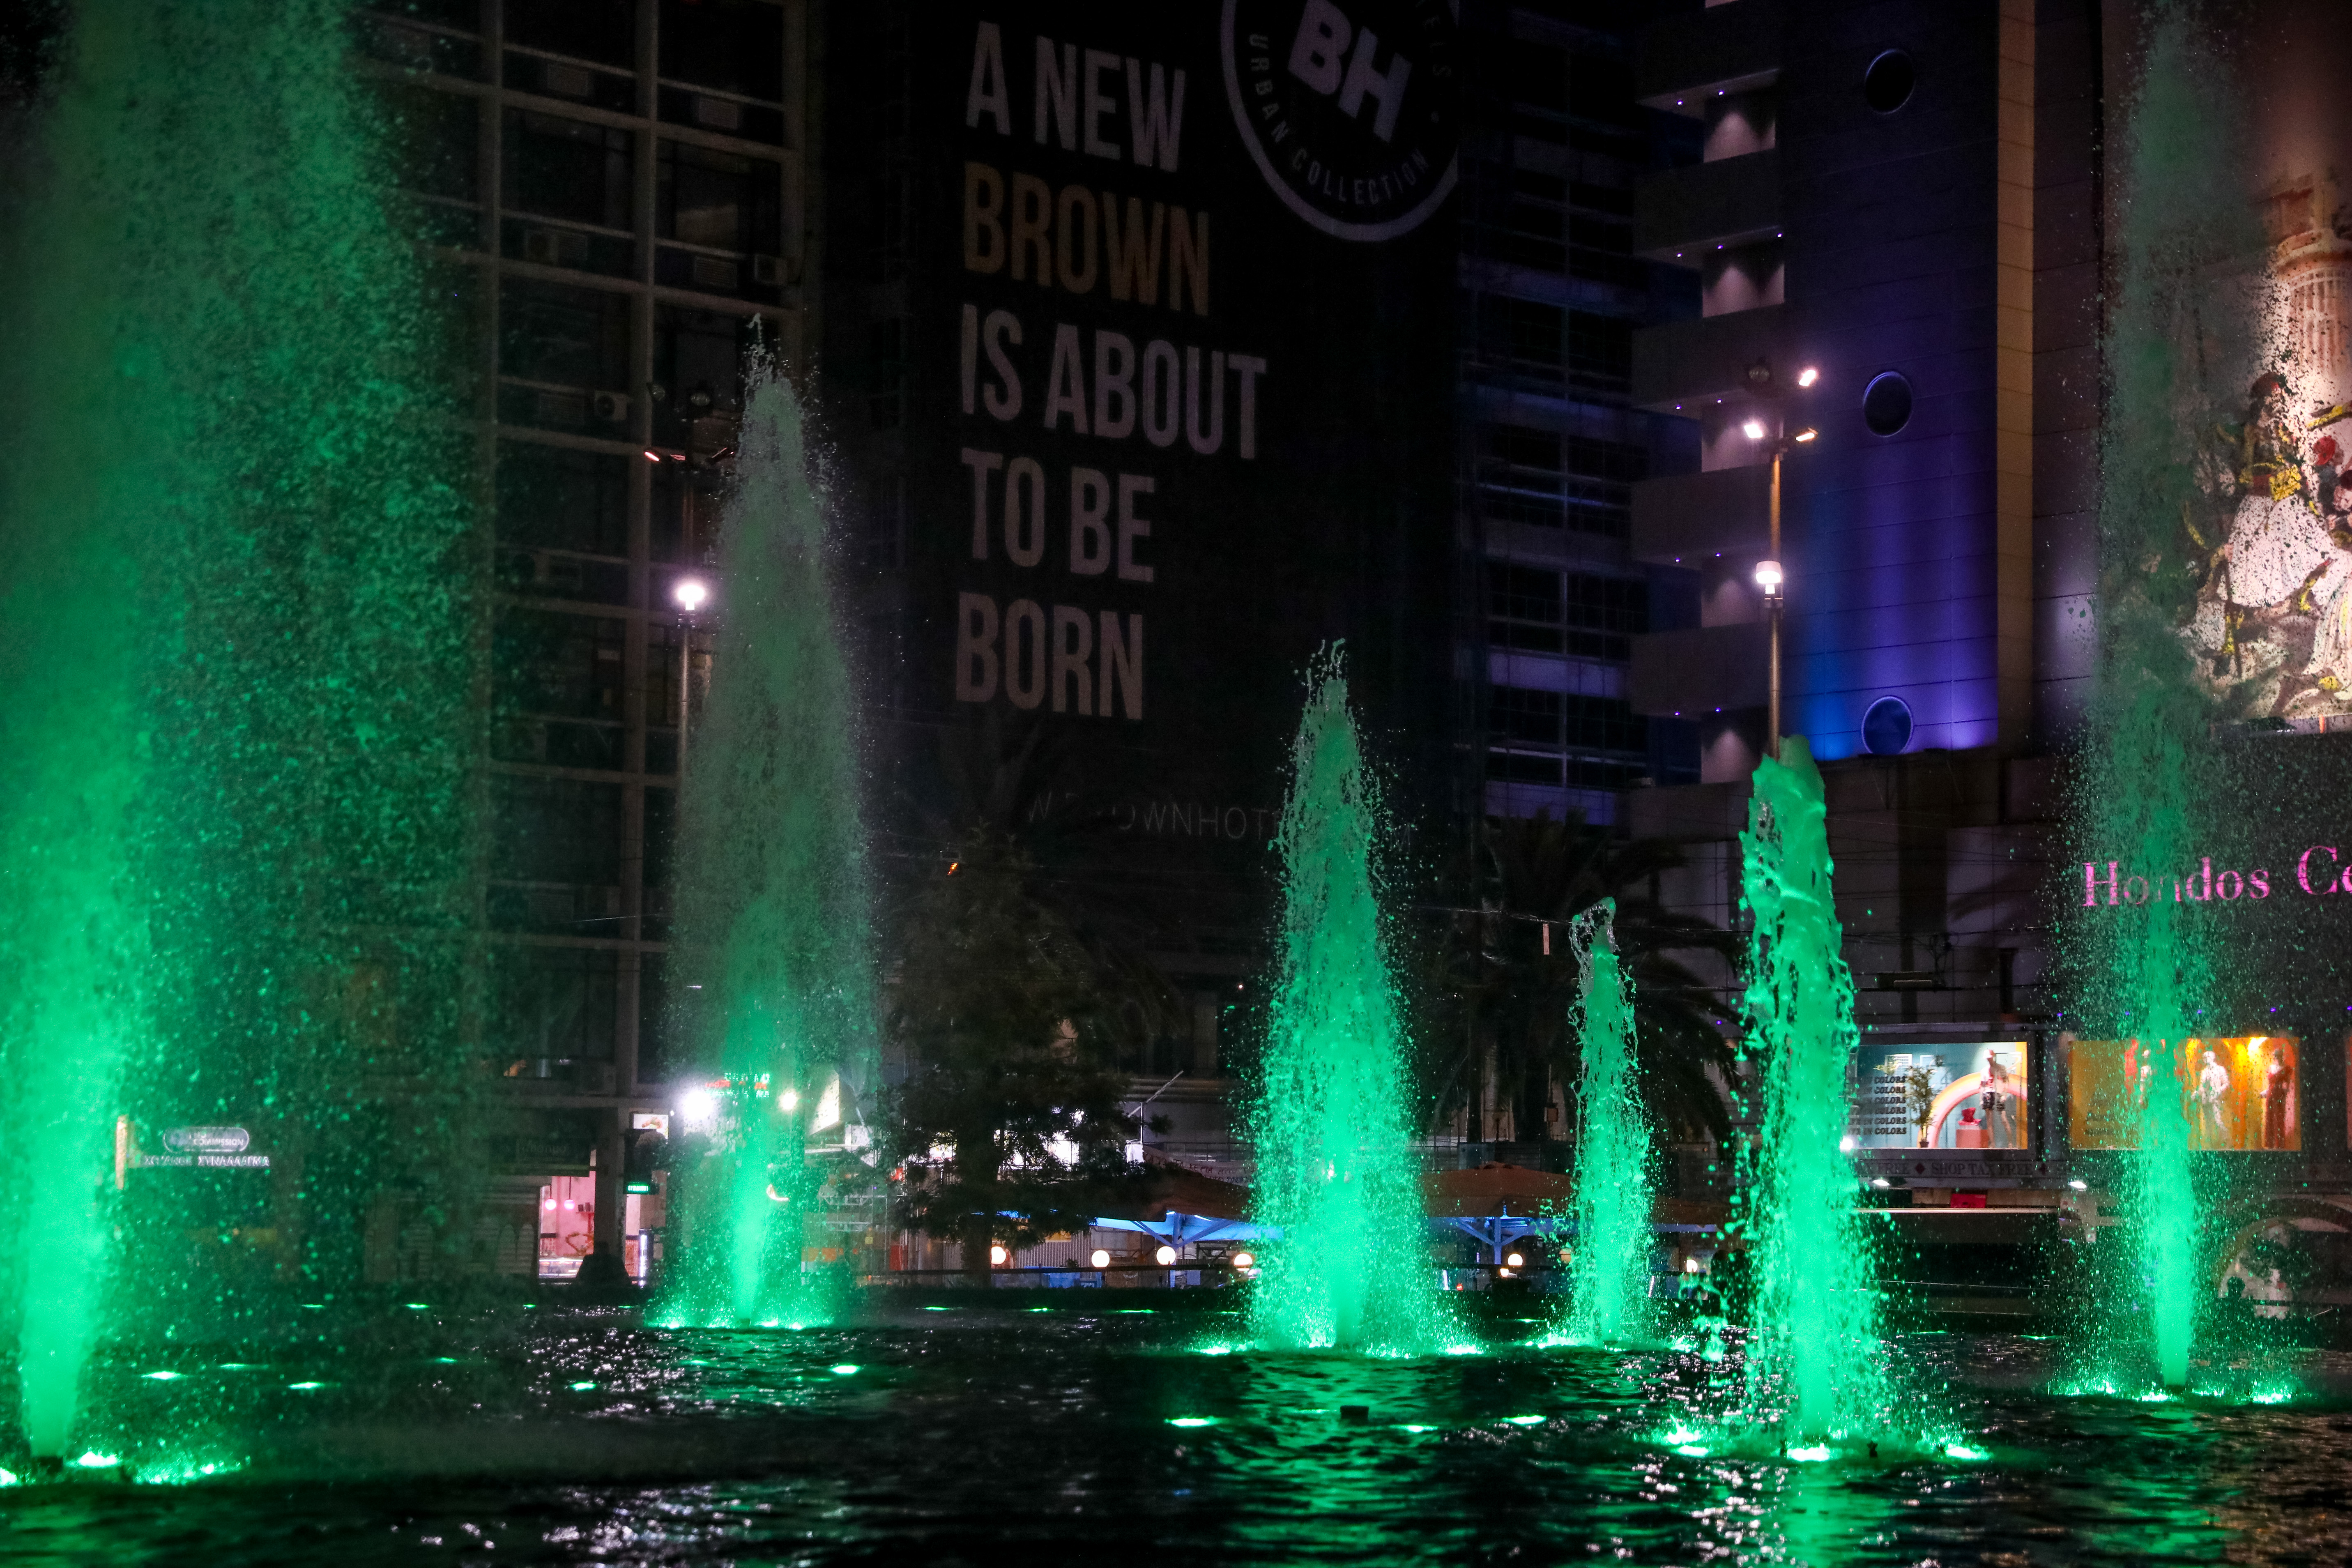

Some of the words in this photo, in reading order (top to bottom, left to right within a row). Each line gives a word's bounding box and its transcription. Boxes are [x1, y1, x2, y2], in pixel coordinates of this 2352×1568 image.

[966, 20, 1011, 136] A
[1034, 35, 1186, 173] NEW
[1247, 33, 1291, 144] URBAN
[1288, 0, 1413, 143] BH
[962, 160, 1210, 318] BROWN
[1290, 147, 1429, 206] COLLECTION
[961, 303, 1023, 421] IS
[1044, 323, 1268, 460] ABOUT
[961, 447, 1045, 567] TO
[1070, 465, 1155, 583] BE
[955, 591, 1143, 721] BORN
[2082, 857, 2270, 906] Hondos
[1931, 1163, 1965, 1175] SHOP
